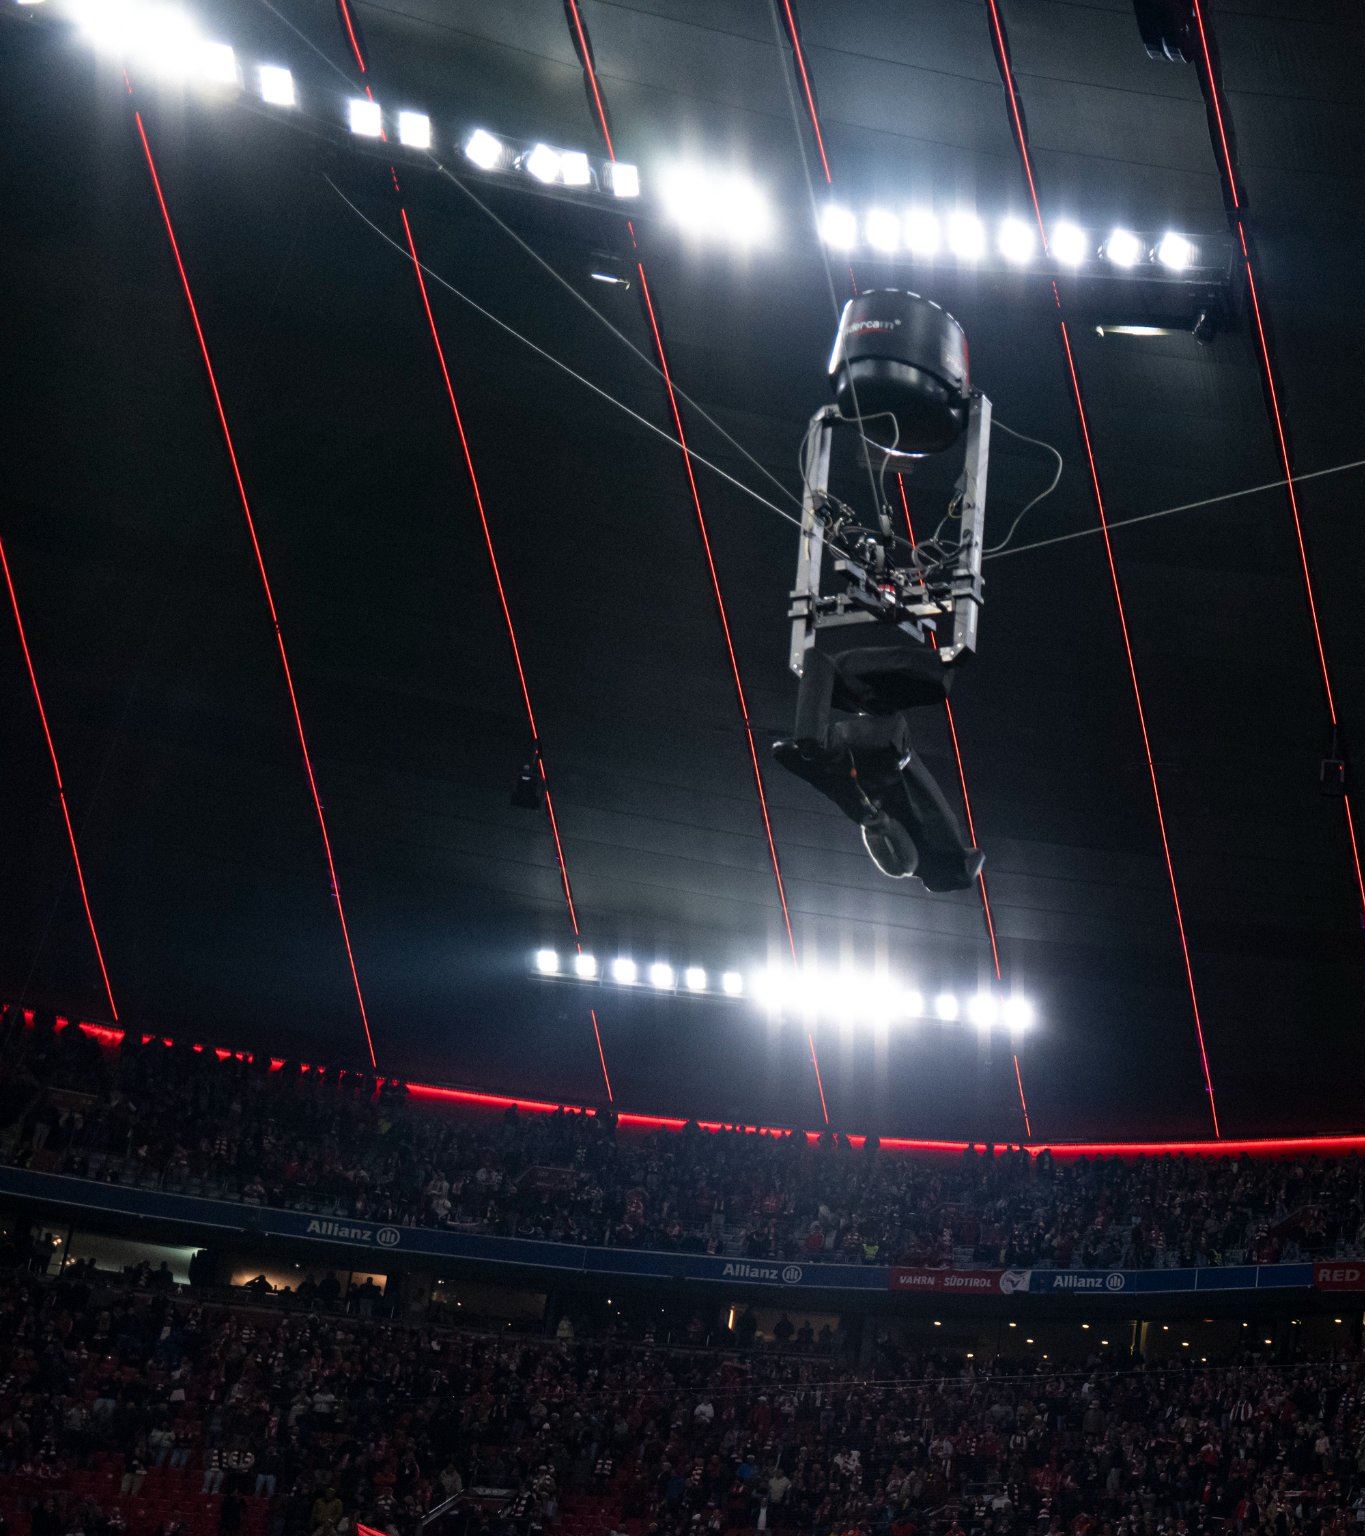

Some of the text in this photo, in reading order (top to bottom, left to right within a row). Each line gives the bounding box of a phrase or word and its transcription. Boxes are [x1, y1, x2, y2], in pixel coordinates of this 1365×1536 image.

[307, 1220, 373, 1243] Allianz
[723, 1262, 779, 1281] Allianz
[1318, 1267, 1360, 1282] RED
[900, 1275, 992, 1288] VAHRN SÜDTIROL
[1053, 1275, 1103, 1288] Allianz
